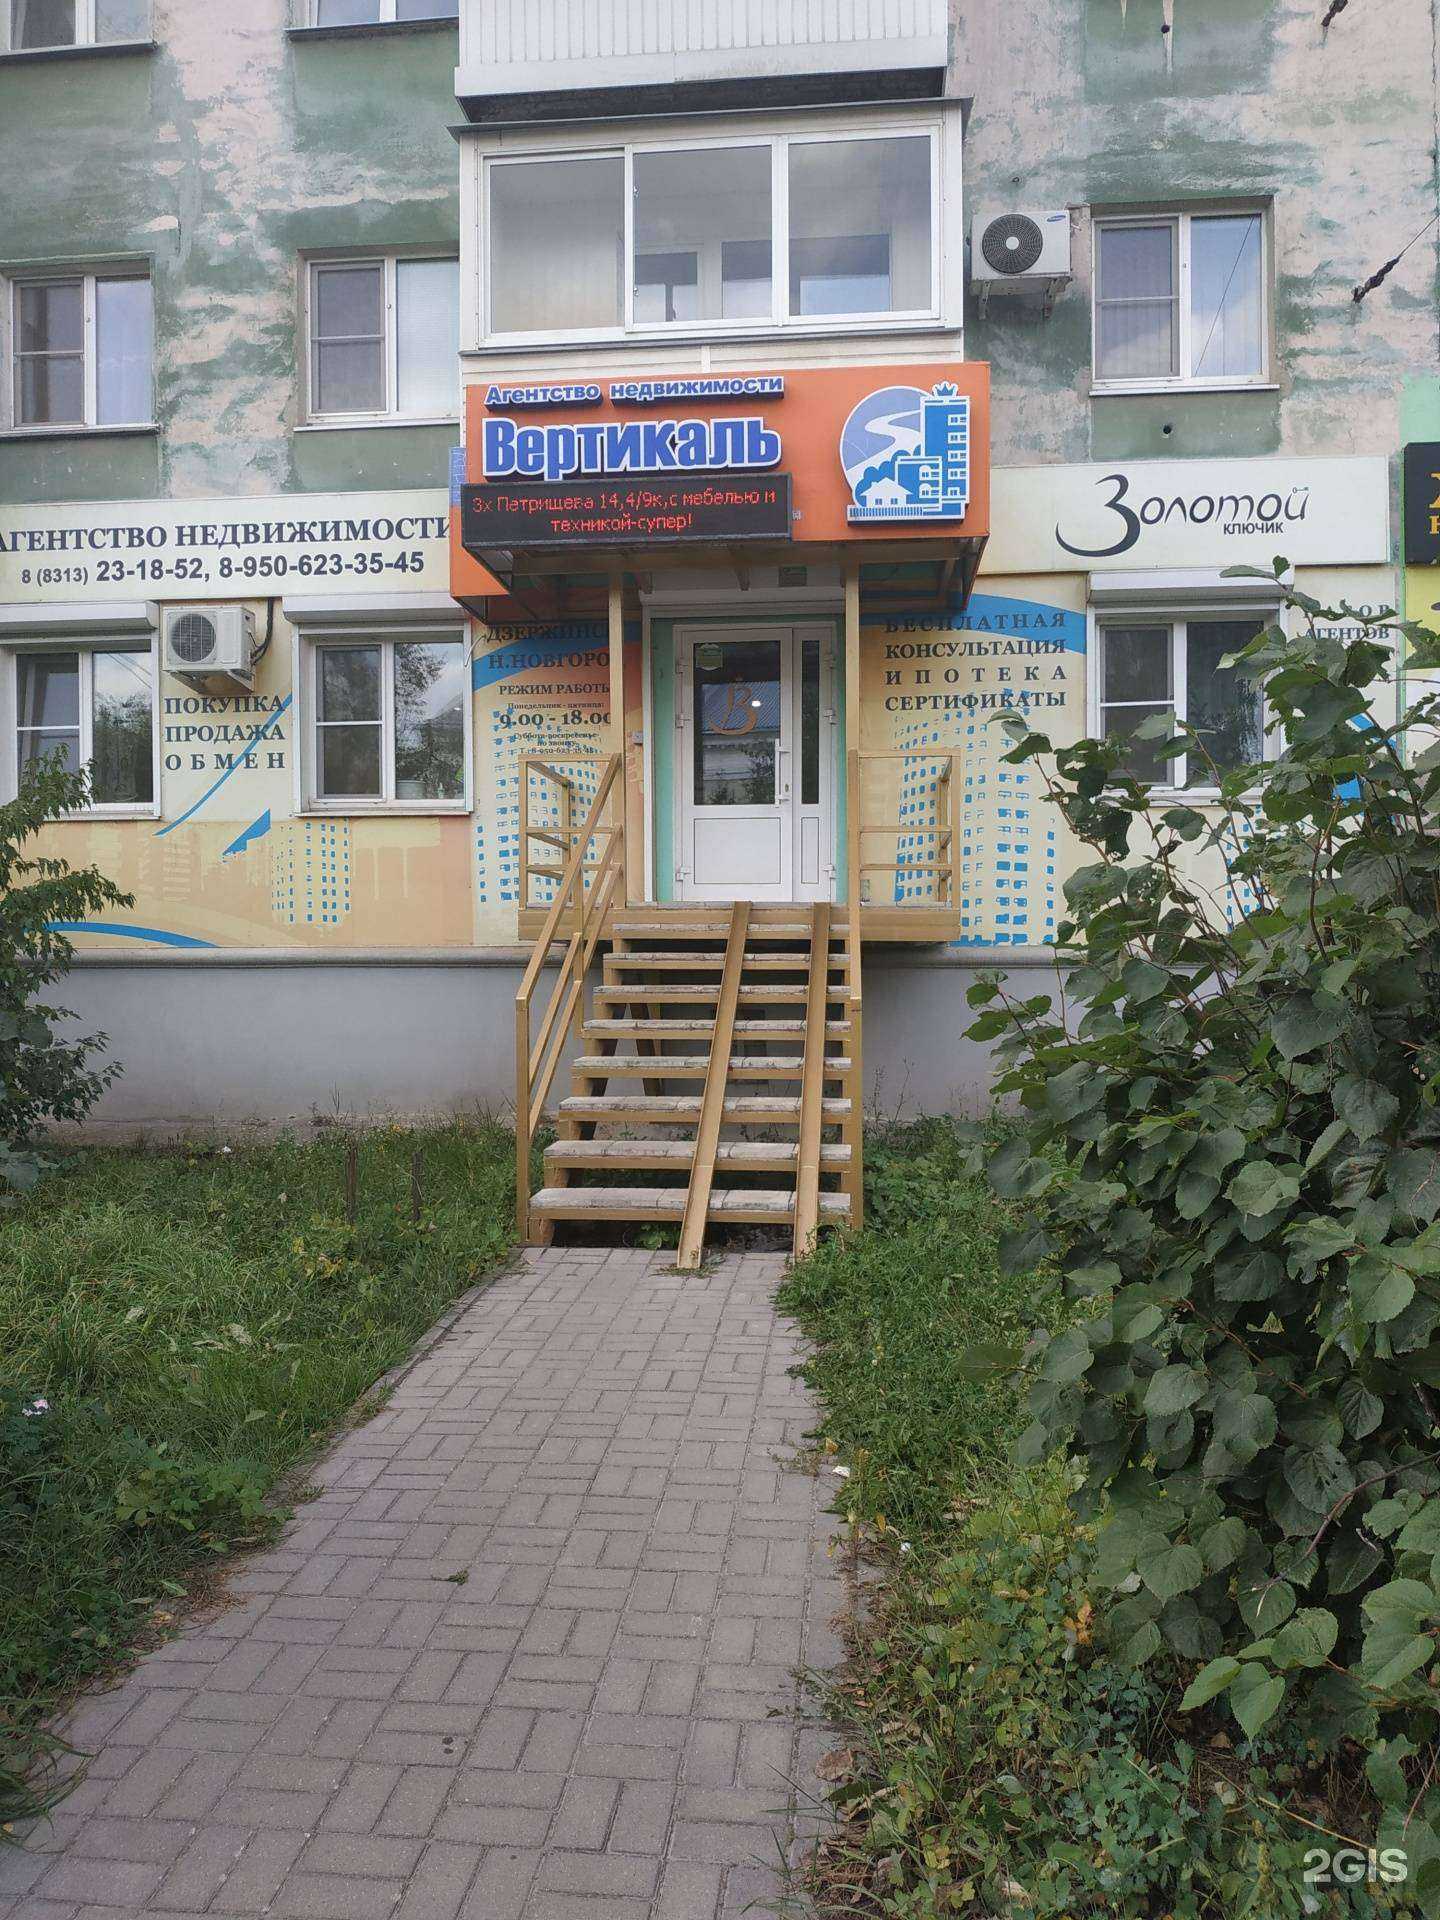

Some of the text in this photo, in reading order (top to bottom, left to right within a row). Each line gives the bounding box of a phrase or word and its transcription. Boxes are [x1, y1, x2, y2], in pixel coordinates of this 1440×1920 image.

[486, 376, 785, 406] Агентство недвижимости
[482, 416, 782, 481] Вертикаль
[1056, 474, 1309, 557] Золотой
[21, 551, 424, 587] 8 (8313) 23-18-52, 8-950-623-35-45
[885, 612, 1066, 633] БЕСПЛАТНАЯ
[885, 639, 1066, 659] КОНСУЛЬТАЦИЯ
[885, 665, 1067, 686] ИПОТЕКА
[498, 684, 556, 696] РЕЖИМ
[164, 695, 286, 714] ПОКУПКА
[885, 691, 1066, 711] СЕРТИФИКАТЫ
[500, 713, 544, 730] 9.00
[164, 723, 285, 744] ПРОДАЖА
[164, 752, 285, 772] ОБМЕН
